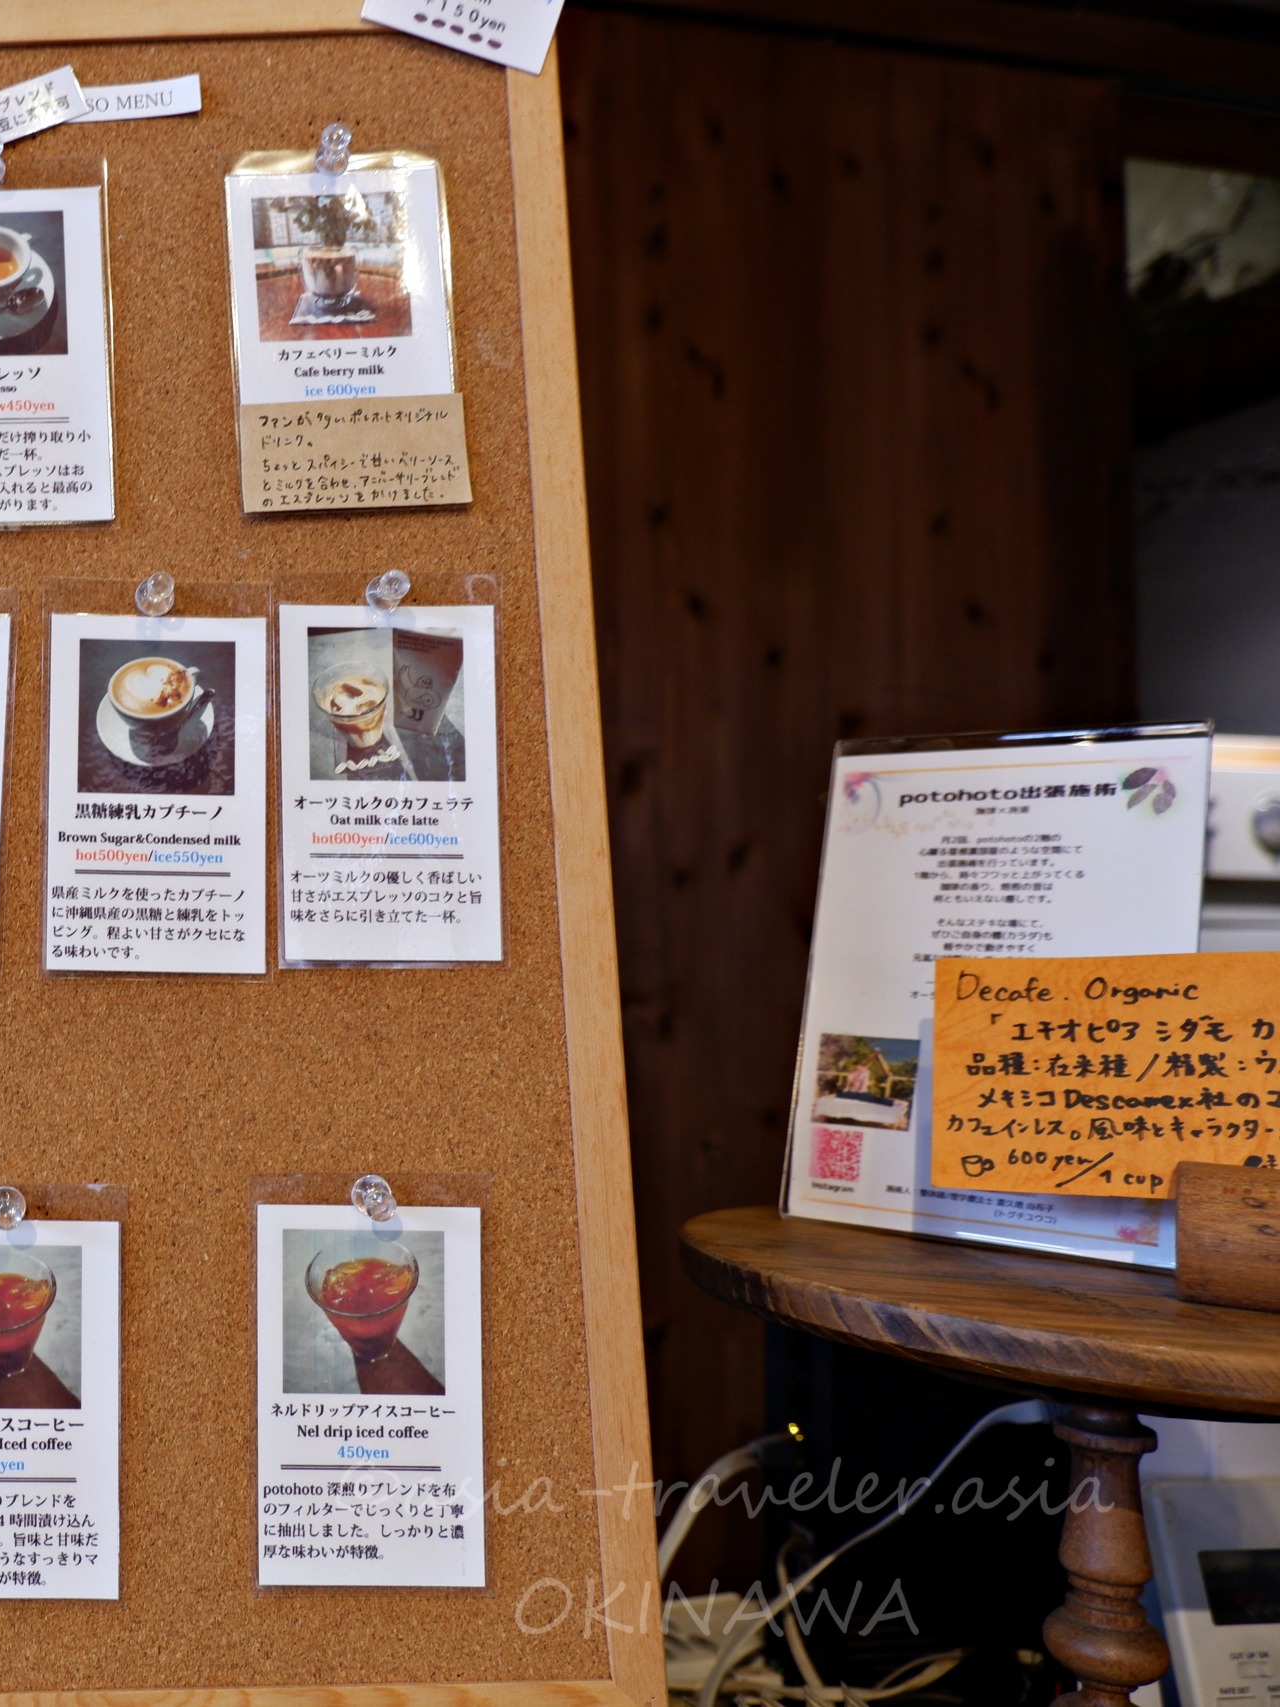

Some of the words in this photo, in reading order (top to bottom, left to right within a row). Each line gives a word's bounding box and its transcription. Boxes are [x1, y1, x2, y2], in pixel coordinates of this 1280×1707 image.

[117, 90, 174, 110] MENU
[279, 345, 397, 361] カフェベリーミルク
[295, 367, 320, 377] Cafe
[323, 366, 354, 379] berry
[358, 365, 384, 376] milk
[294, 796, 474, 811] オーツミルクのカフェラテ
[75, 803, 223, 821] 黒糖練乳カプチーノ
[330, 815, 351, 825] Oat
[354, 815, 381, 825] milk
[385, 815, 409, 826] cafe
[412, 815, 439, 826] latte
[58, 832, 96, 842] Brown
[100, 833, 210, 846] Sugar&Condensed
[214, 836, 241, 846] milk
[290, 871, 482, 885] オーツミルクの優しく香ばしい
[52, 886, 245, 903] 県産ミルクを使ったカプチーノ
[291, 889, 482, 905] 甘さがエスプレッソのコクと旨
[52, 906, 245, 922] に沖縄県産の黒糖と練乳をトッ
[291, 909, 462, 924] 味をさらに引き立てた一杯。
[52, 925, 245, 942] ピング。程よい甘さがクセにな
[52, 945, 140, 960] る味わいです。
[1085, 977, 1199, 1005] Organic
[270, 1403, 455, 1419] ネルドリップアイスコーヒー
[297, 1425, 319, 1437] Nel
[324, 1425, 353, 1441] drip
[356, 1425, 384, 1439] iced
[388, 1426, 429, 1439] coffee
[0, 1438, 27, 1450] Iced
[31, 1438, 72, 1450] coffee
[338, 1445, 389, 1462] 450yen
[264, 1503, 464, 1519] のフィルターでじっくりと丁寧
[264, 1523, 464, 1539] に抽出しました。しっかりと濃
[263, 1545, 386, 1560] 厚な味わいが特徴。
